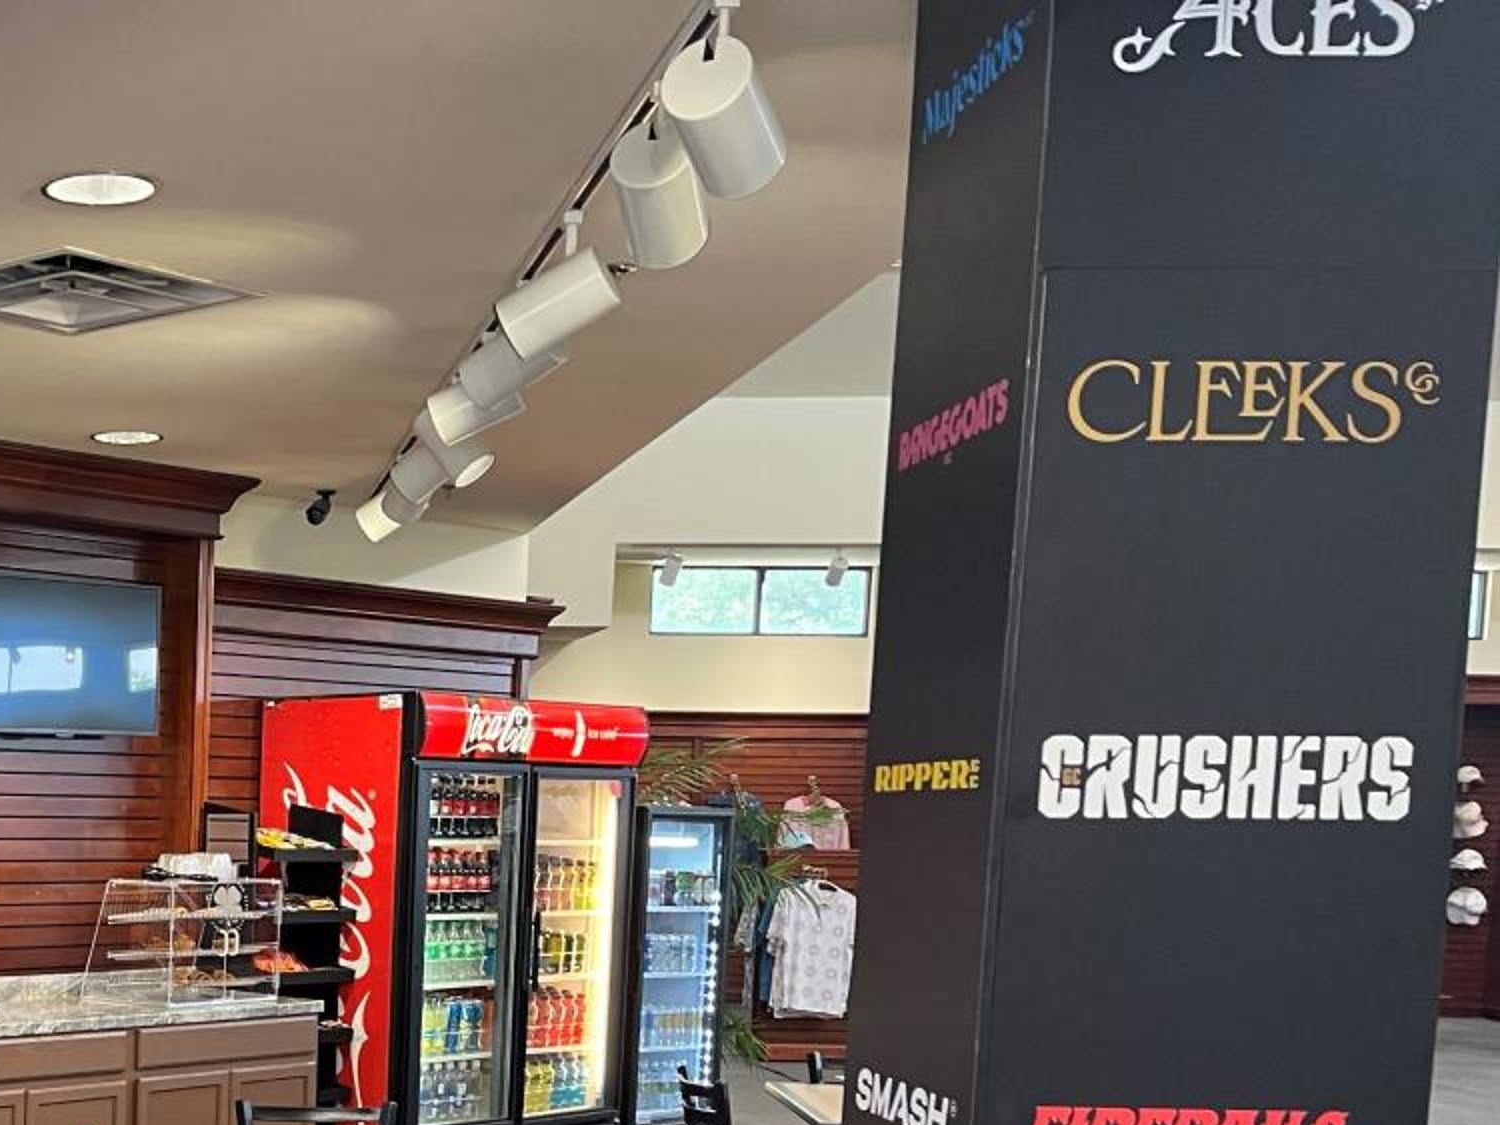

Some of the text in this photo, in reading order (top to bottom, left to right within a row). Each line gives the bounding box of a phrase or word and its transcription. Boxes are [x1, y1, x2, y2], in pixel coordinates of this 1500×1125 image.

[1067, 359, 1403, 444] CLEEKS
[874, 759, 969, 793] RIPPER
[1037, 734, 1415, 821] CRUSHERS
